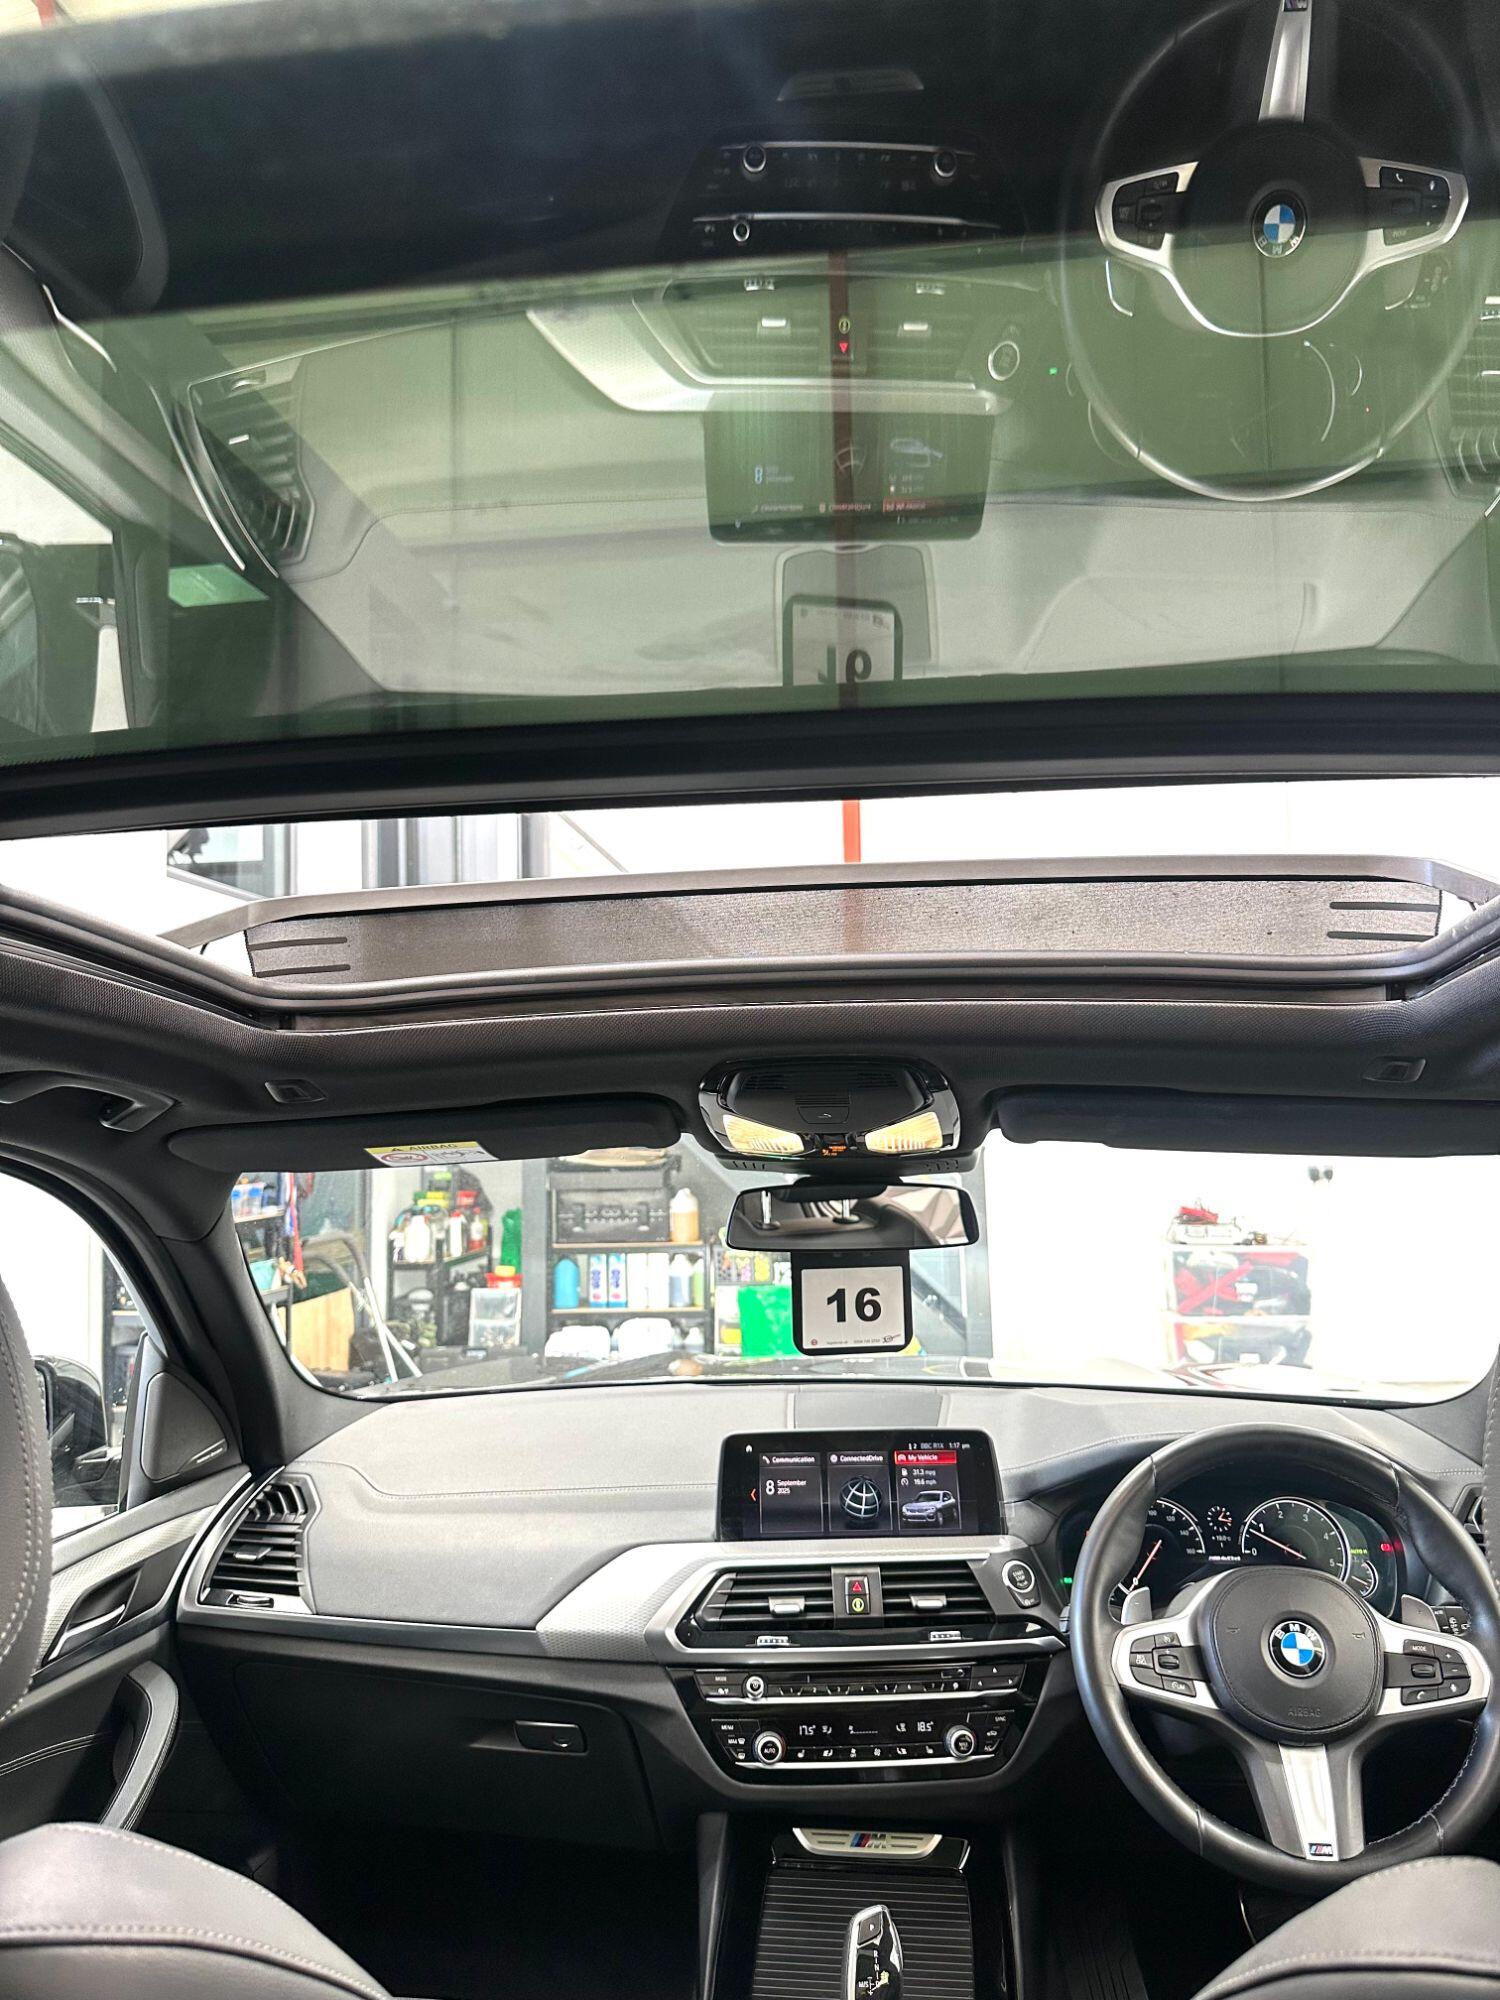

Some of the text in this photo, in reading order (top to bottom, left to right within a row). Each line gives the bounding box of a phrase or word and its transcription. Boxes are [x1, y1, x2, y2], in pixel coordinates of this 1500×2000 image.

[410, 1143, 458, 1151] AIRBAG
[826, 1287, 881, 1323] 16
[772, 1455, 816, 1464] Communication
[840, 1454, 884, 1463] ConnectedDrive
[908, 1453, 938, 1462] My Vehicle
[765, 1479, 775, 1495] 8
[777, 1479, 807, 1487] September
[1278, 1511, 1284, 1519] 2
[1303, 1514, 1309, 1522] 3
[1259, 1523, 1264, 1533] 1
[1323, 1532, 1329, 1540] 4
[1251, 1547, 1257, 1556] 0
[1132, 1576, 1139, 1586] 0
[869, 1923, 875, 1932] P
